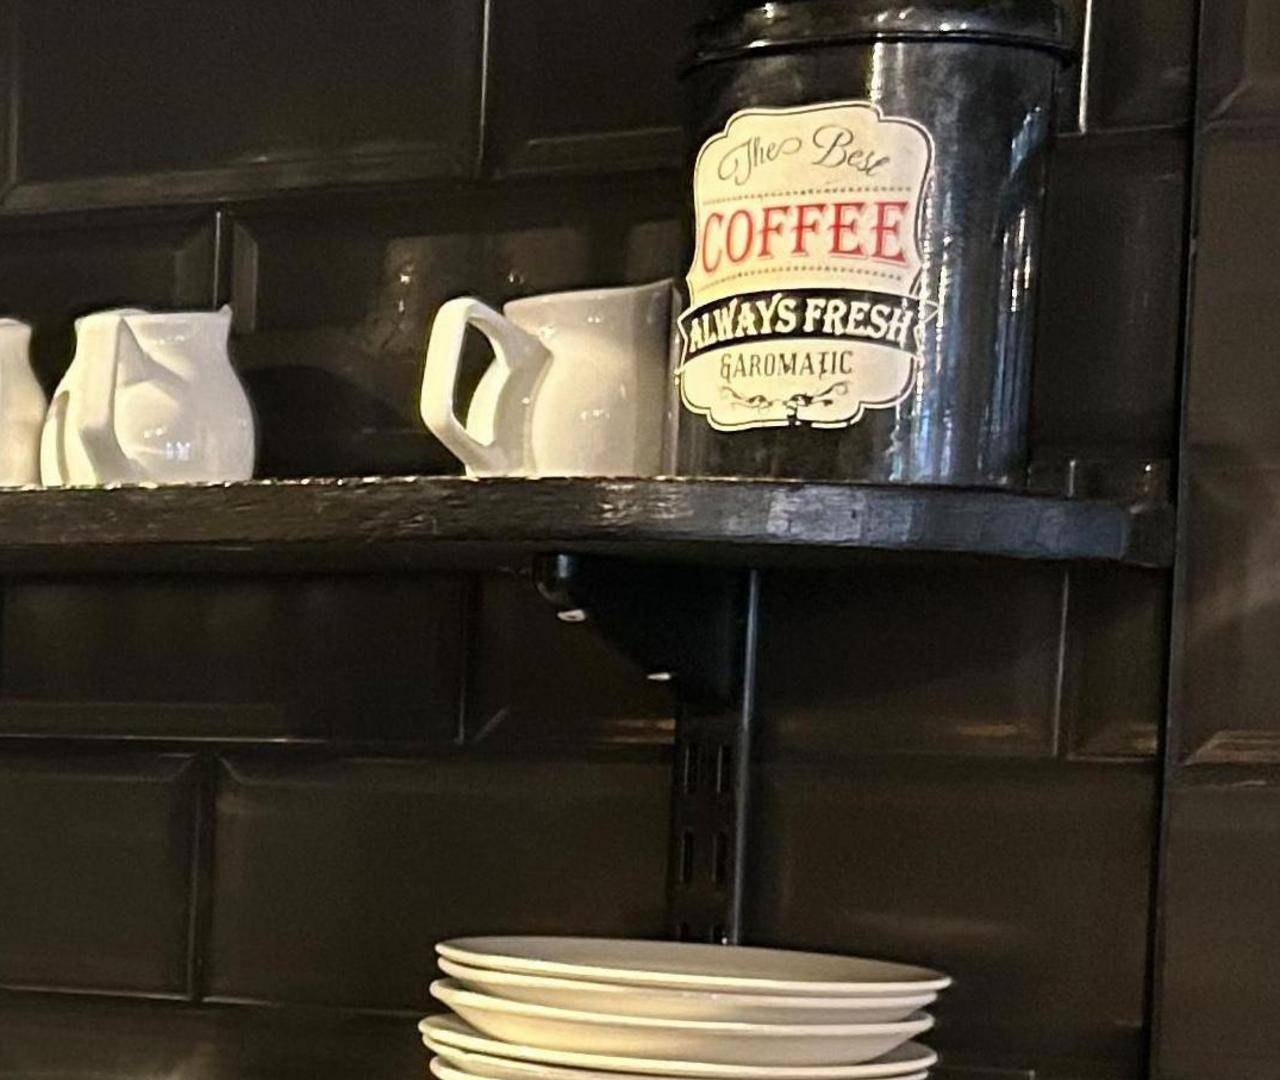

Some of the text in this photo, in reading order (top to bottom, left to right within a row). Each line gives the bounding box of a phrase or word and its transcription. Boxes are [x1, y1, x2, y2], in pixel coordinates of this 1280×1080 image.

[718, 124, 890, 186] The Best
[702, 201, 909, 273] COFFEE
[690, 293, 914, 353] ALWAYS FRESH
